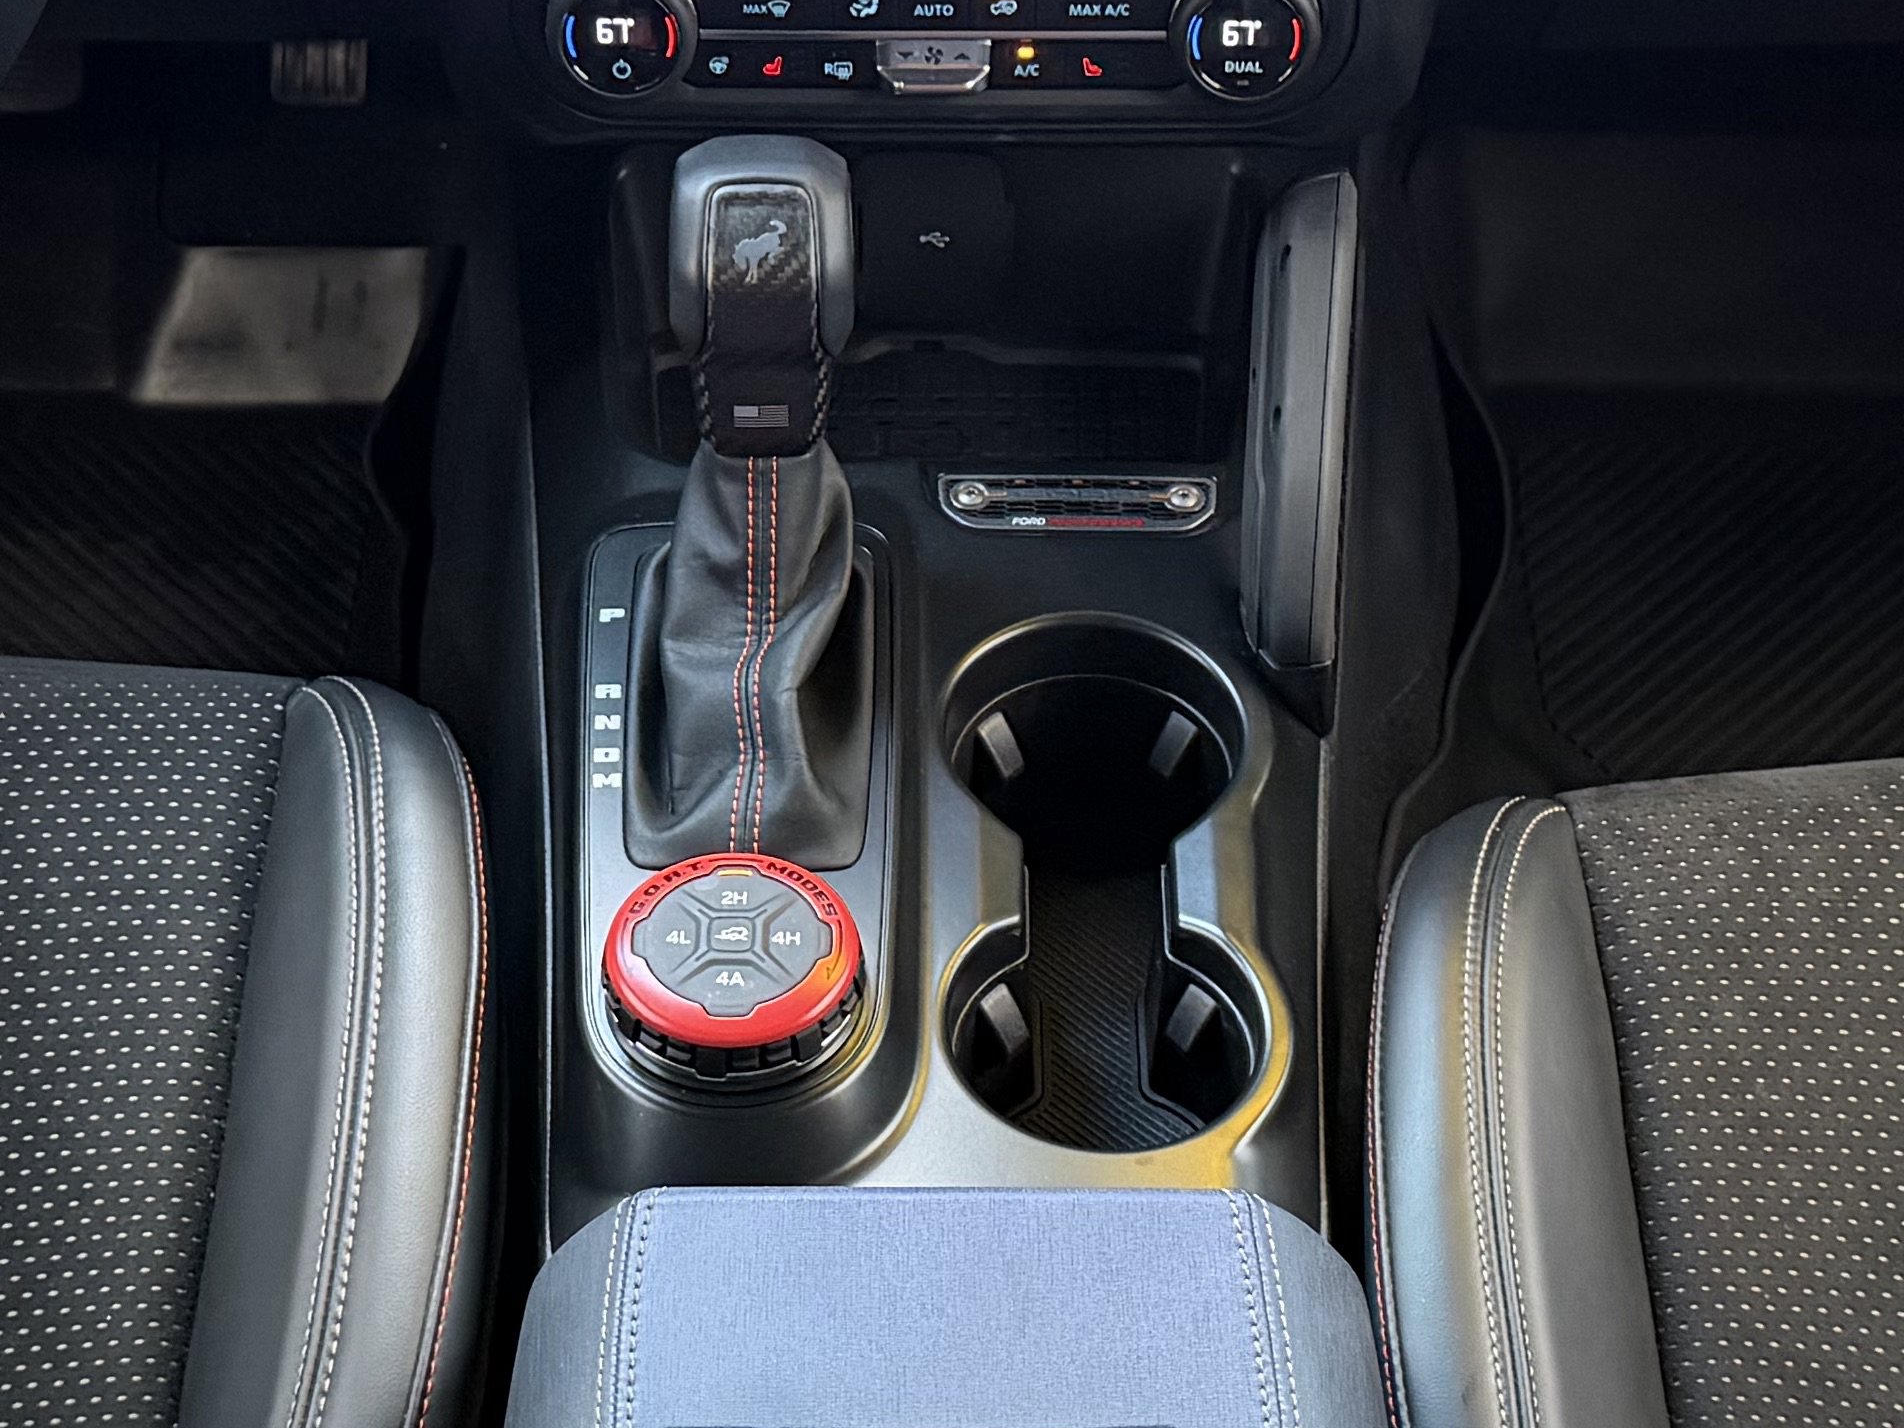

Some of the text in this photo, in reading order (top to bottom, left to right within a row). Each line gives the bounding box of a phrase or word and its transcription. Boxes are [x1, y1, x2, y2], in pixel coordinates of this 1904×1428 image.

[743, 3, 768, 15] MAX
[913, 3, 954, 18] AUTO
[1069, 3, 1130, 18] MAX A/C
[1014, 63, 1040, 78] A/C
[1225, 61, 1263, 74] DUAL
[1011, 517, 1046, 526] FORD
[599, 608, 626, 623] P
[594, 714, 622, 730] N
[592, 773, 623, 789] M
[765, 861, 840, 917] MODES
[721, 891, 748, 905] 2H
[665, 930, 692, 945] 4L
[771, 930, 802, 946] 4H
[715, 971, 745, 987] 4A
